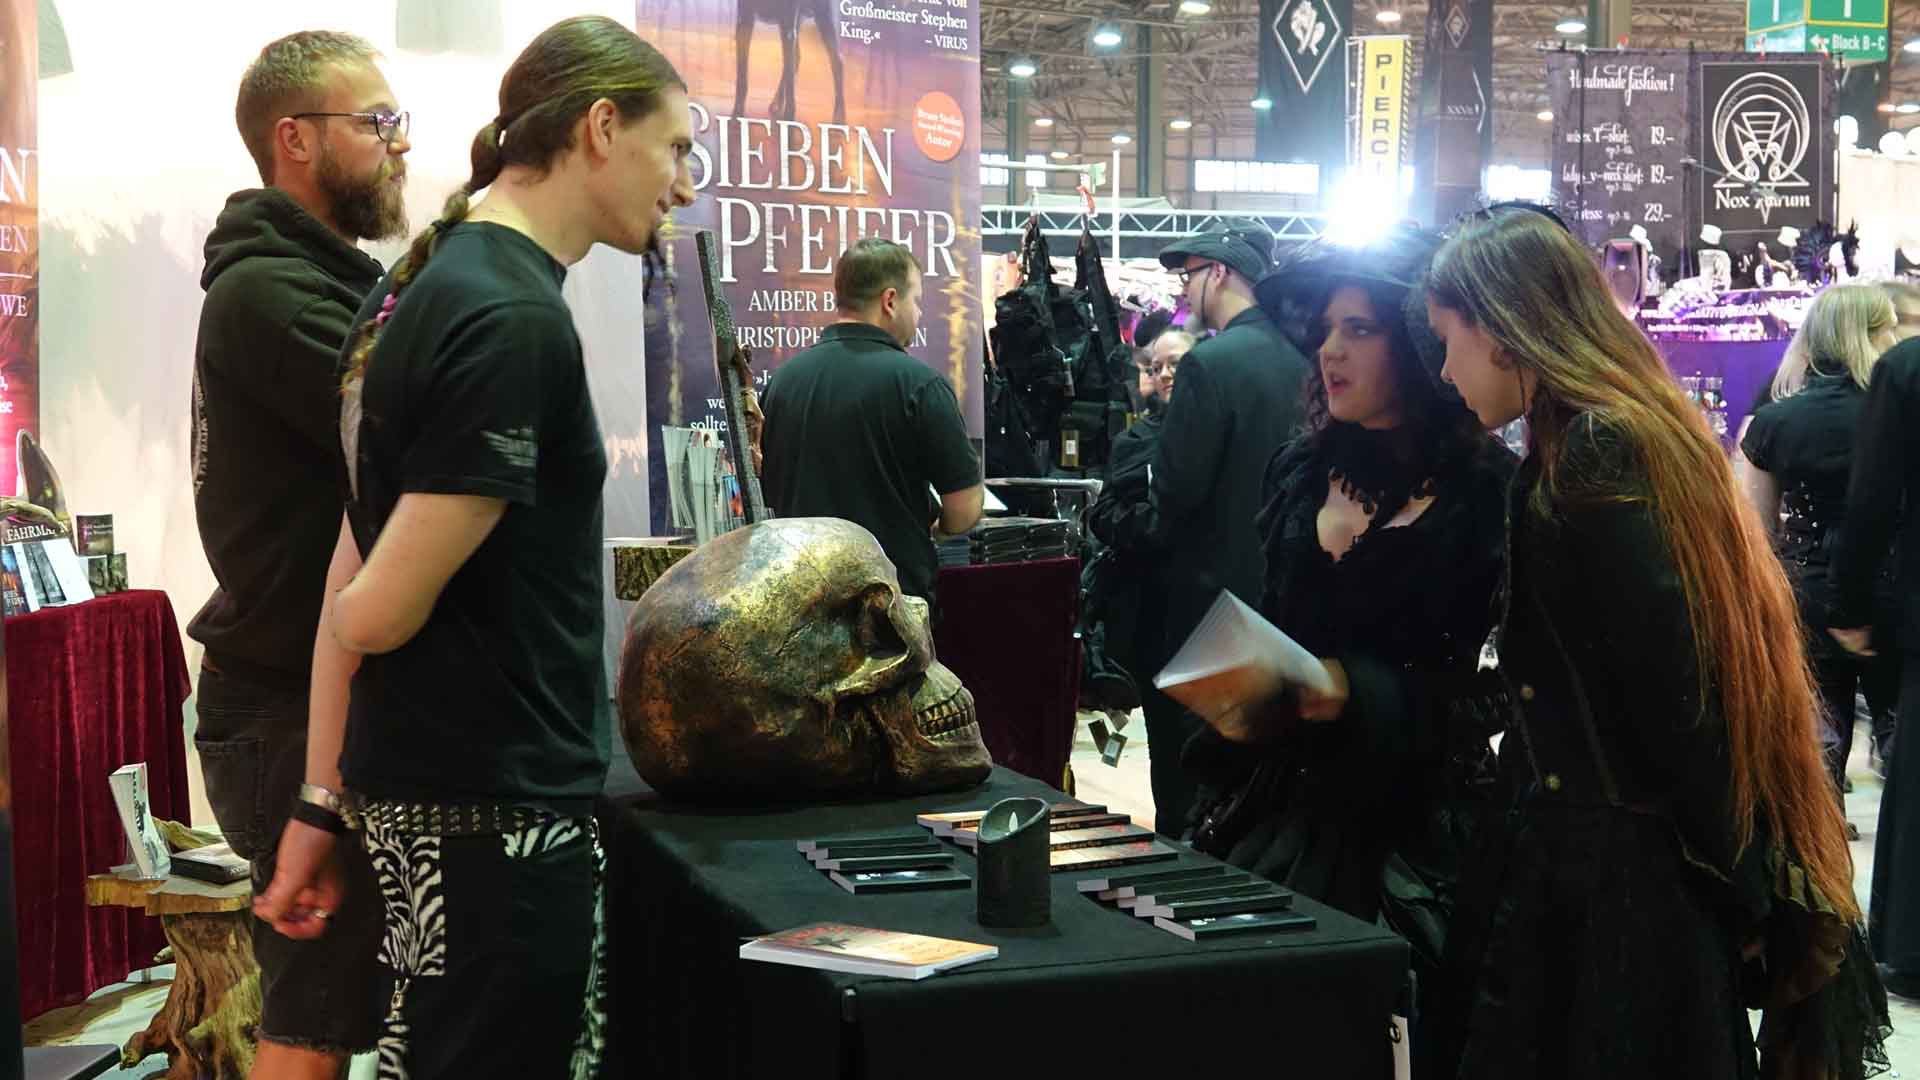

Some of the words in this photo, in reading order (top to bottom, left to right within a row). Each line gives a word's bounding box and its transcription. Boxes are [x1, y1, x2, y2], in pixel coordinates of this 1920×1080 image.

[840, 0, 918, 24] Großmeister
[921, 9, 968, 31] Stephen
[840, 21, 881, 44] King.«
[934, 34, 968, 50] VIRUS
[1832, 33, 1859, 50] Block
[687, 102, 896, 196] SIEBEN
[1715, 188, 1751, 210] Nox
[748, 289, 818, 312] AMBER
